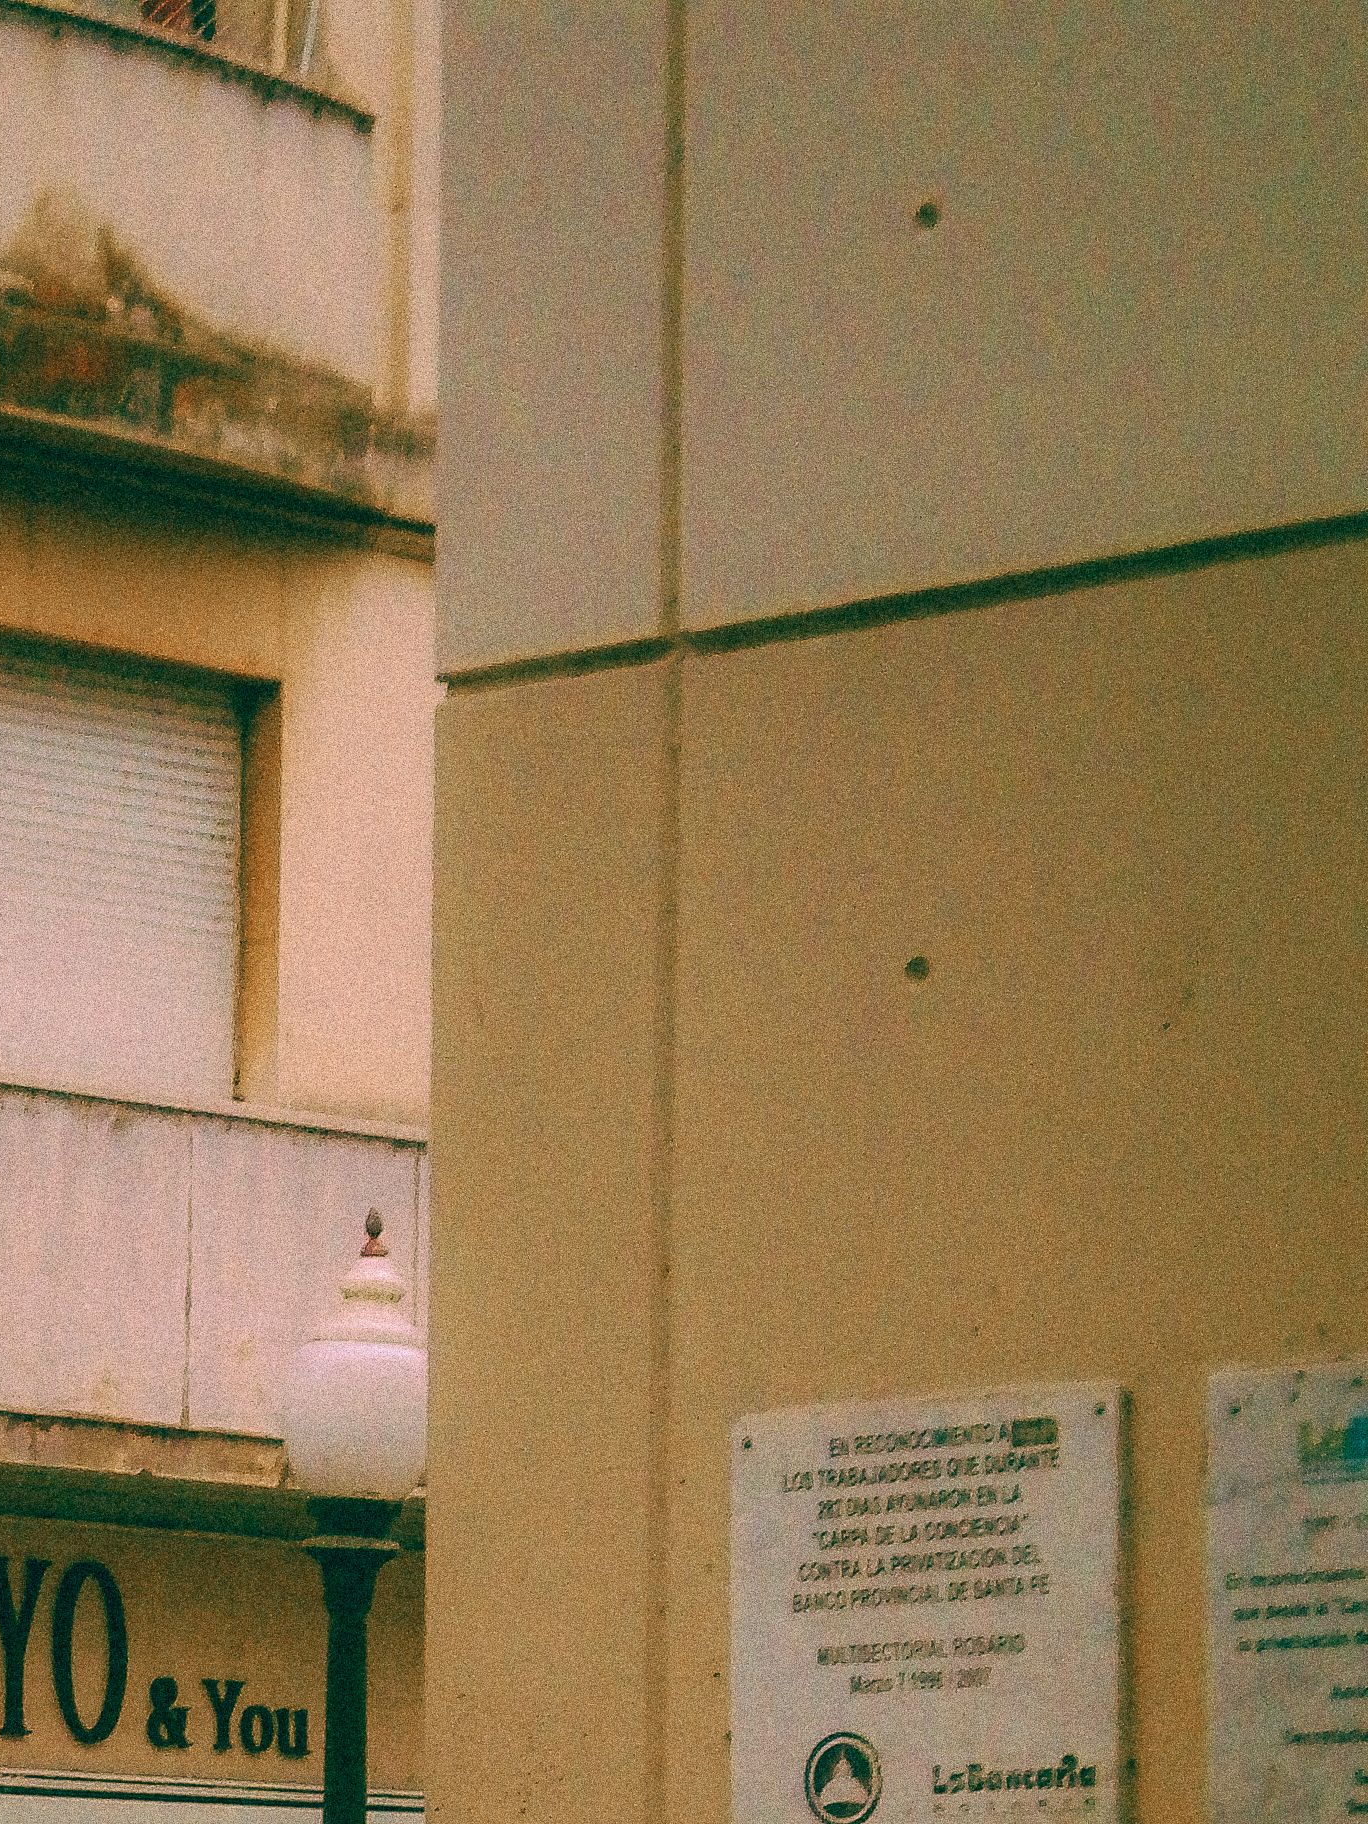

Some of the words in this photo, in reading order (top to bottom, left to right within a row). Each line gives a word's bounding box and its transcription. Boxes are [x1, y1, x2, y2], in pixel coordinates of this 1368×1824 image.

[829, 1437, 849, 1458] EN
[854, 1423, 994, 1455] RECONOCIMIENTO
[999, 1423, 1011, 1442] A
[783, 1471, 813, 1493] LOS
[818, 1459, 941, 1488] TRABAJADORES
[947, 1456, 979, 1477] QUE
[985, 1447, 1060, 1475] DURANTE
[977, 1485, 997, 1506] EN
[1003, 1484, 1021, 1504] LA
[874, 1525, 895, 1546] DE
[901, 1524, 918, 1543] LA
[798, 1559, 860, 1582] CONTRA
[866, 1557, 886, 1576] LA
[1012, 1544, 1041, 1565] DEL
[792, 1591, 845, 1613] BANCO
[850, 1584, 943, 1609] PROVINCIAL
[947, 1582, 968, 1602] DE
[973, 1577, 1024, 1599] SANTA
[1031, 1574, 1050, 1595] FE
[953, 1634, 1026, 1657] ROSARIO
[147, 1675, 192, 1750] &
[202, 1678, 310, 1759] You
